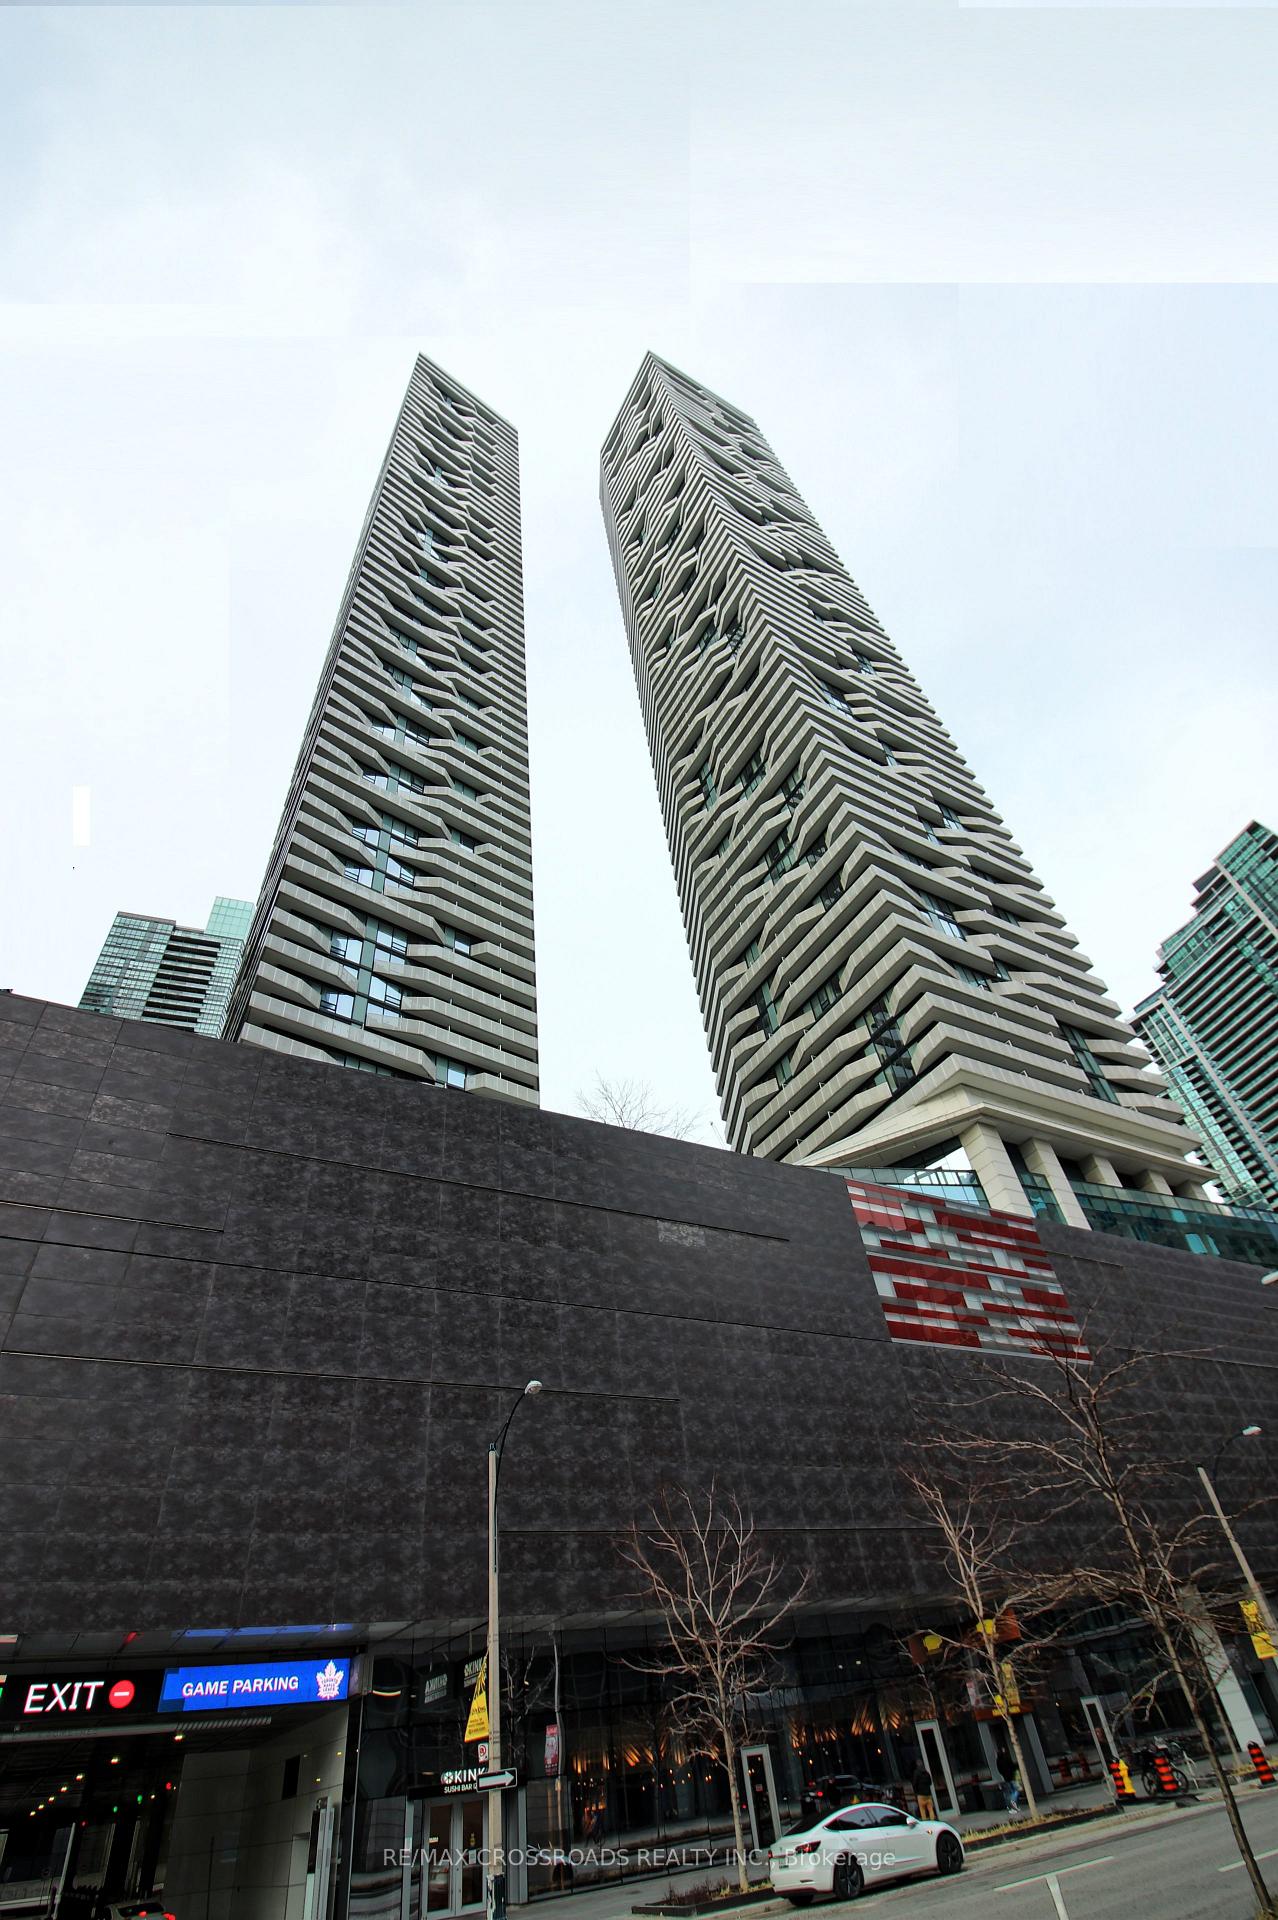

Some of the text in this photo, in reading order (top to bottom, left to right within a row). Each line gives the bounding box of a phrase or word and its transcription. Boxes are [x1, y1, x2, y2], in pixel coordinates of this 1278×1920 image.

[23, 1680, 105, 1714] EXIT
[182, 1675, 299, 1697] GAME PARKING
[444, 1784, 461, 1793] SUSHI
[462, 1783, 473, 1791] BAR
